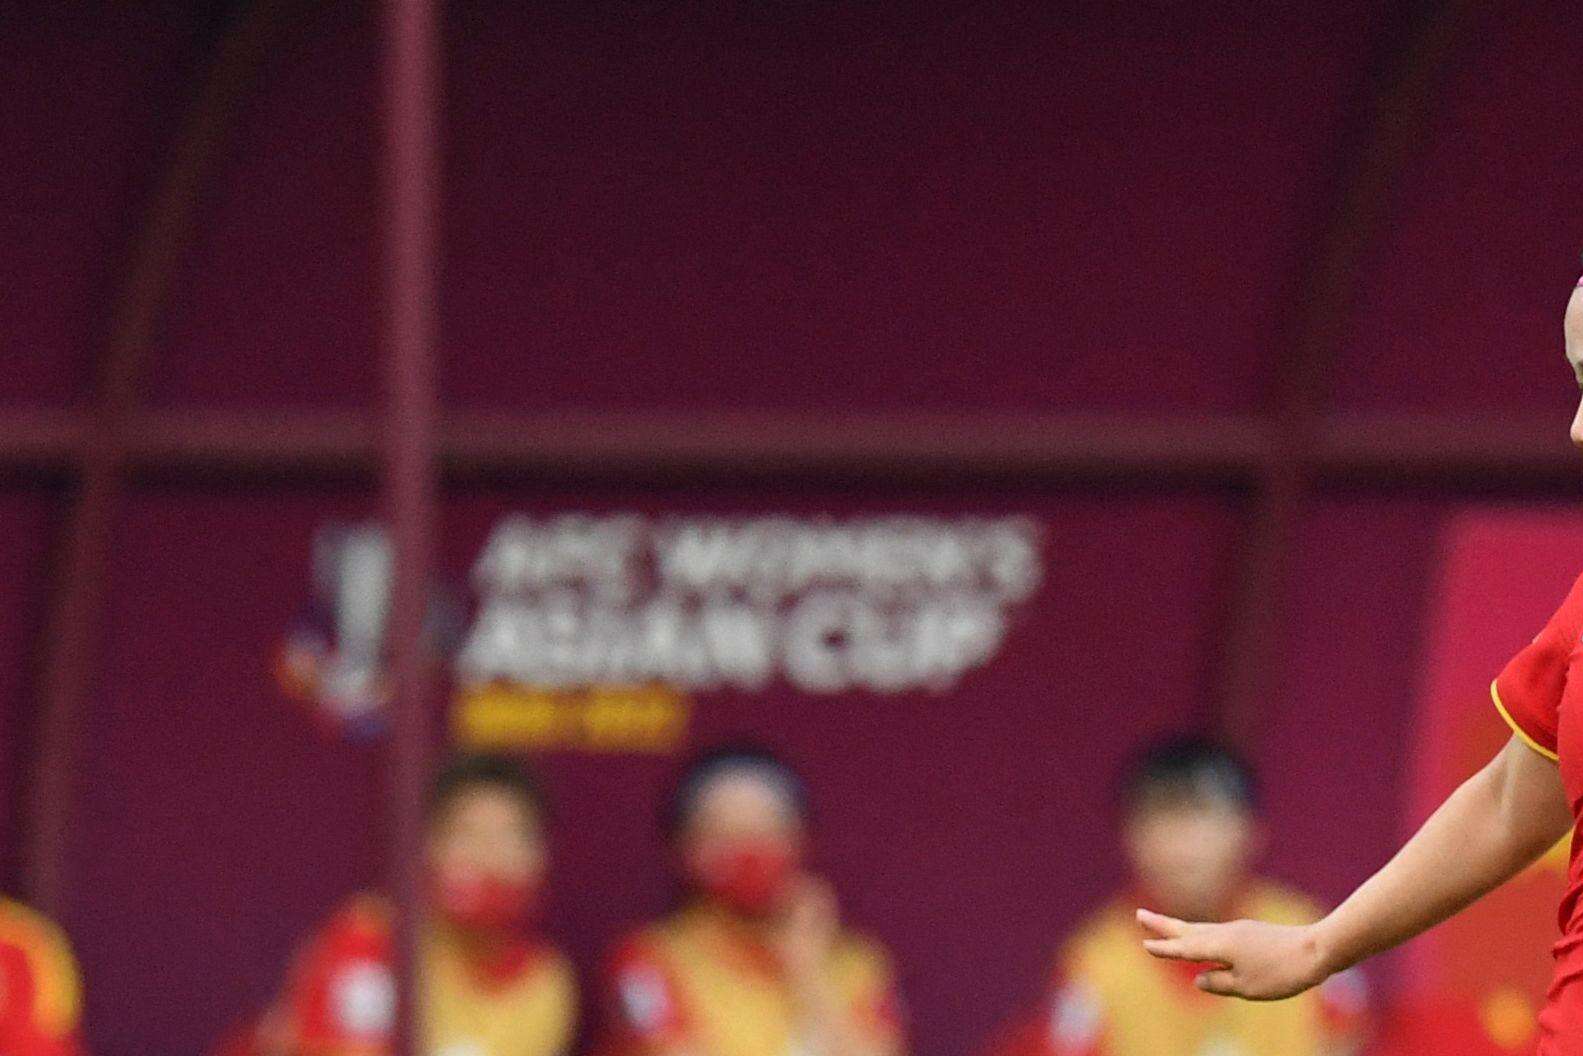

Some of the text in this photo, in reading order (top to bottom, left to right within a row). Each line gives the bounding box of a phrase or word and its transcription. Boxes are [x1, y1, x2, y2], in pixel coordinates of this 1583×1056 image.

[476, 518, 648, 596] AFC
[459, 596, 1003, 689] ASIAN CUP
